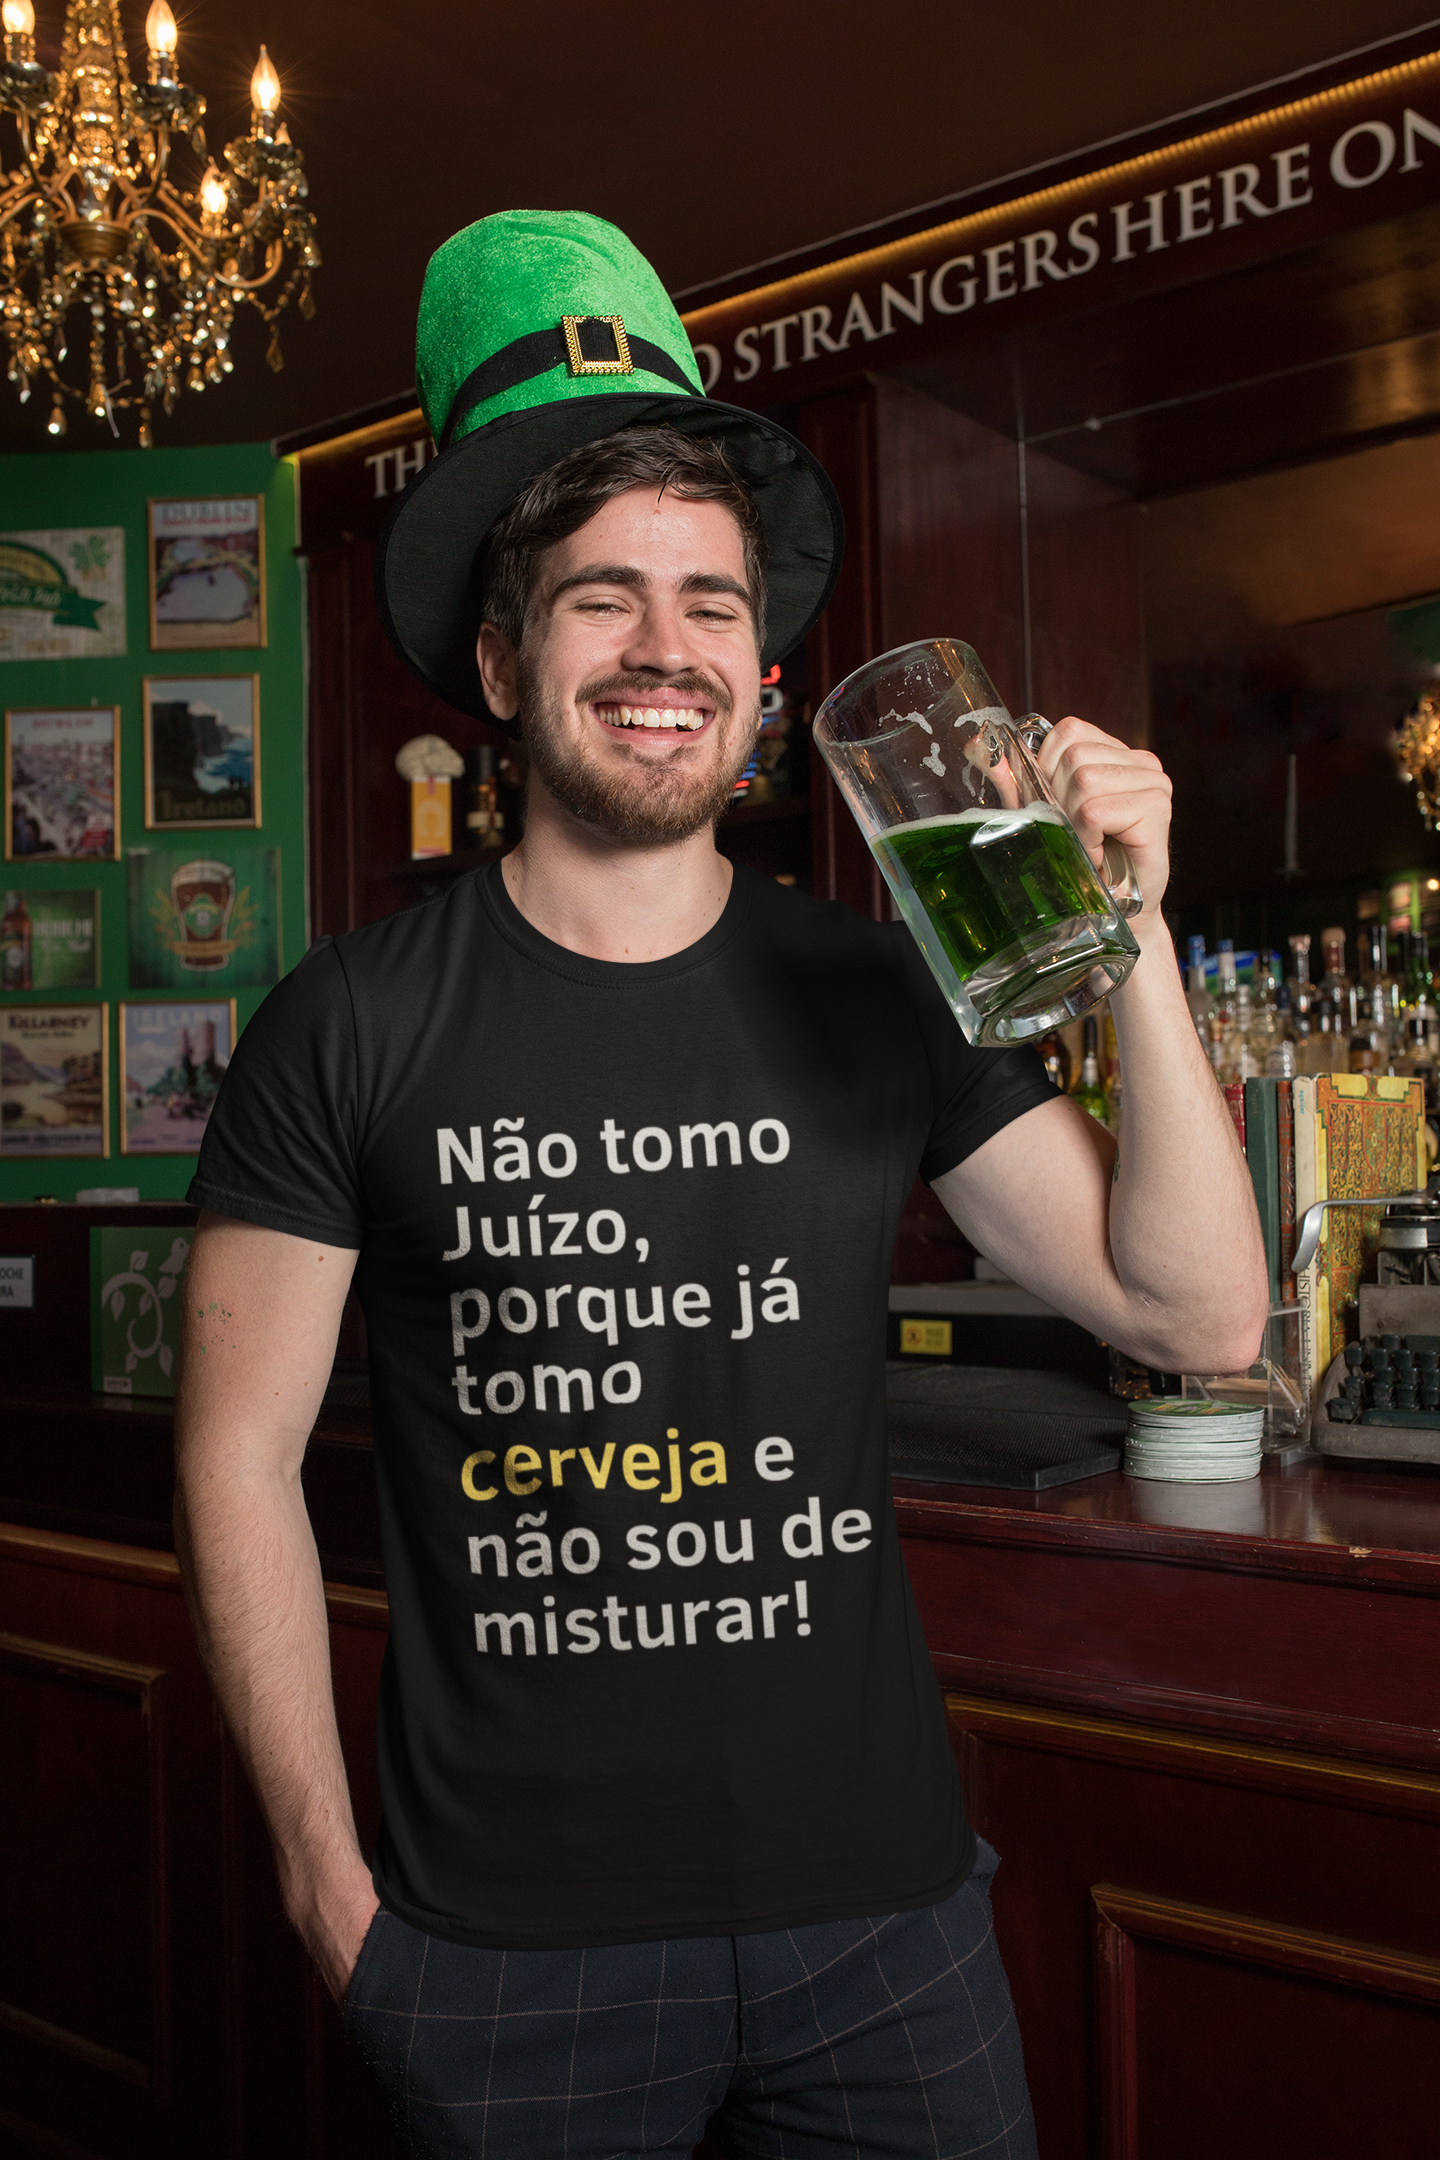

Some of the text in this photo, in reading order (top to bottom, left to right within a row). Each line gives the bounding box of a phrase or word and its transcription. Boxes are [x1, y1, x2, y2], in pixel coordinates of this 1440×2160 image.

[364, 435, 439, 499] TH
[734, 212, 1100, 382] STRANGERS
[1109, 143, 1314, 262] HERE
[436, 1116, 791, 1185] Não tomo
[443, 1193, 650, 1263] Juízo,
[449, 1257, 801, 1357] porque já
[451, 1360, 642, 1415] tomo
[460, 1427, 795, 1503] cerveja e
[467, 1495, 873, 1578] não sou de
[473, 1579, 812, 1656] misturar!
